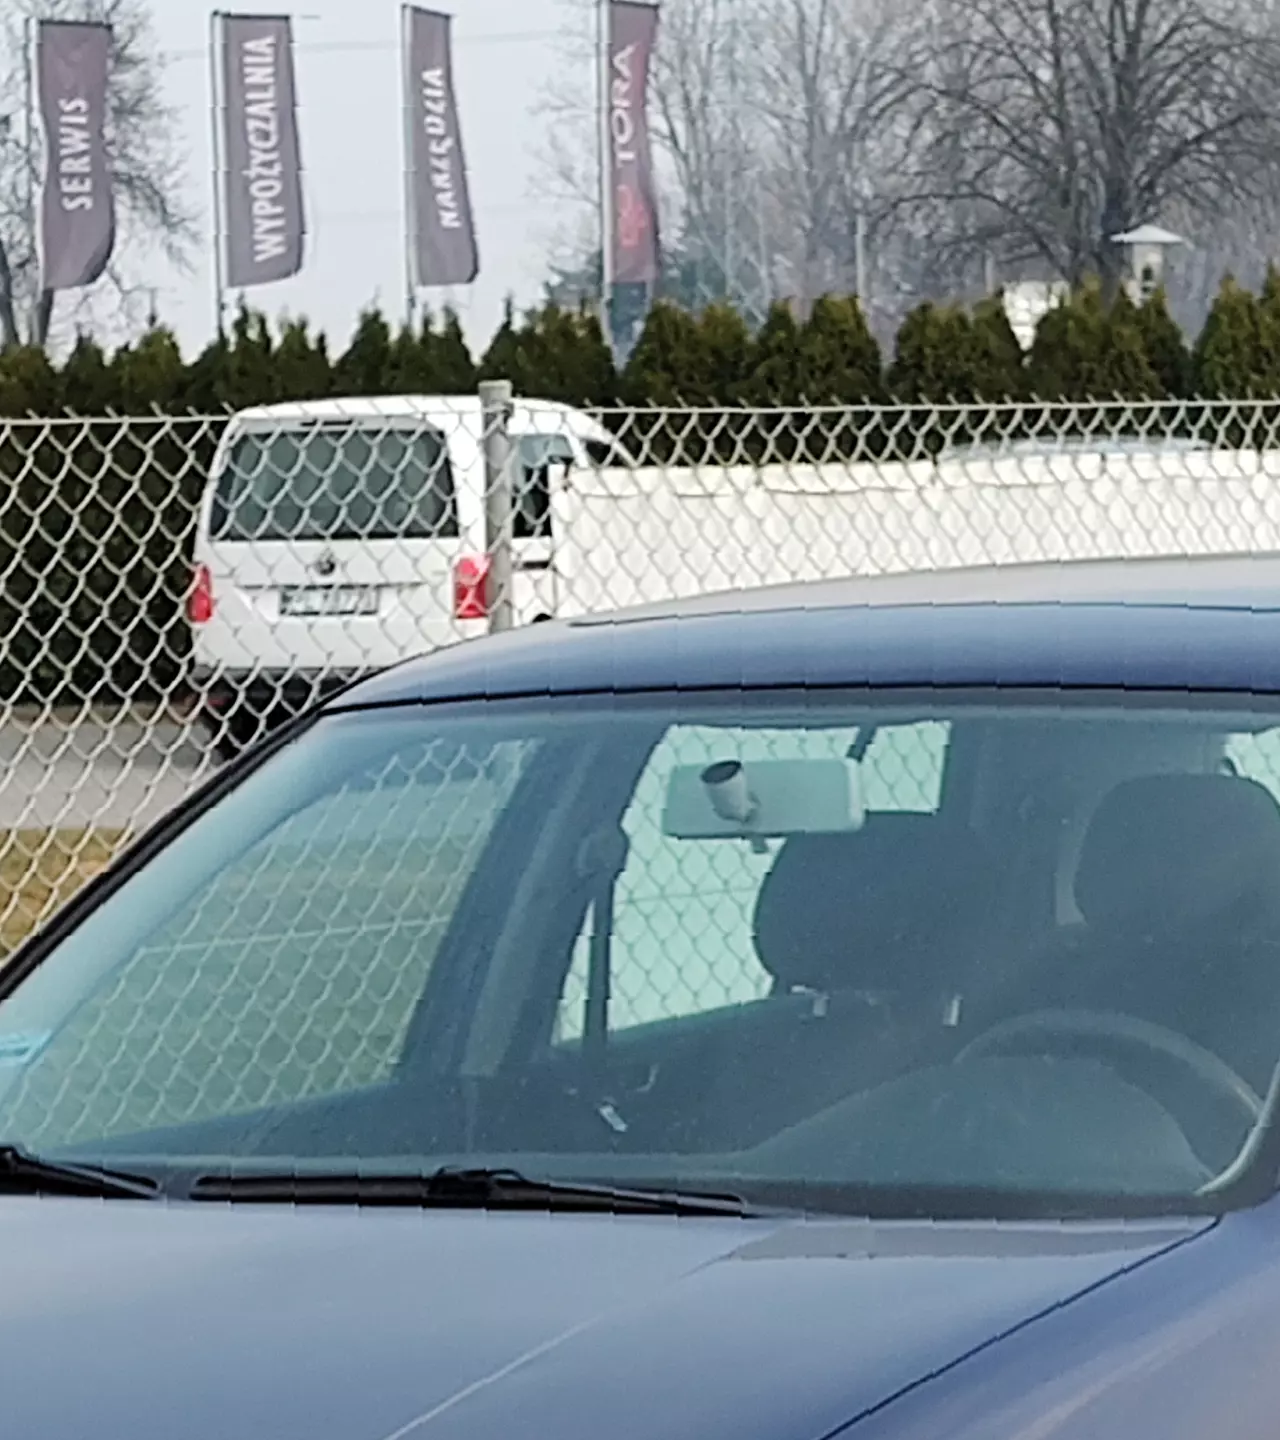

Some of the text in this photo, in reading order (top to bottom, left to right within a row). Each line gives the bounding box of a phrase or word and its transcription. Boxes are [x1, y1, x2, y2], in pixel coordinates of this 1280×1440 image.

[58, 97, 94, 211] SERWIS
[241, 35, 287, 263] WYPOŻYCZALNIA
[612, 42, 640, 168] TORA
